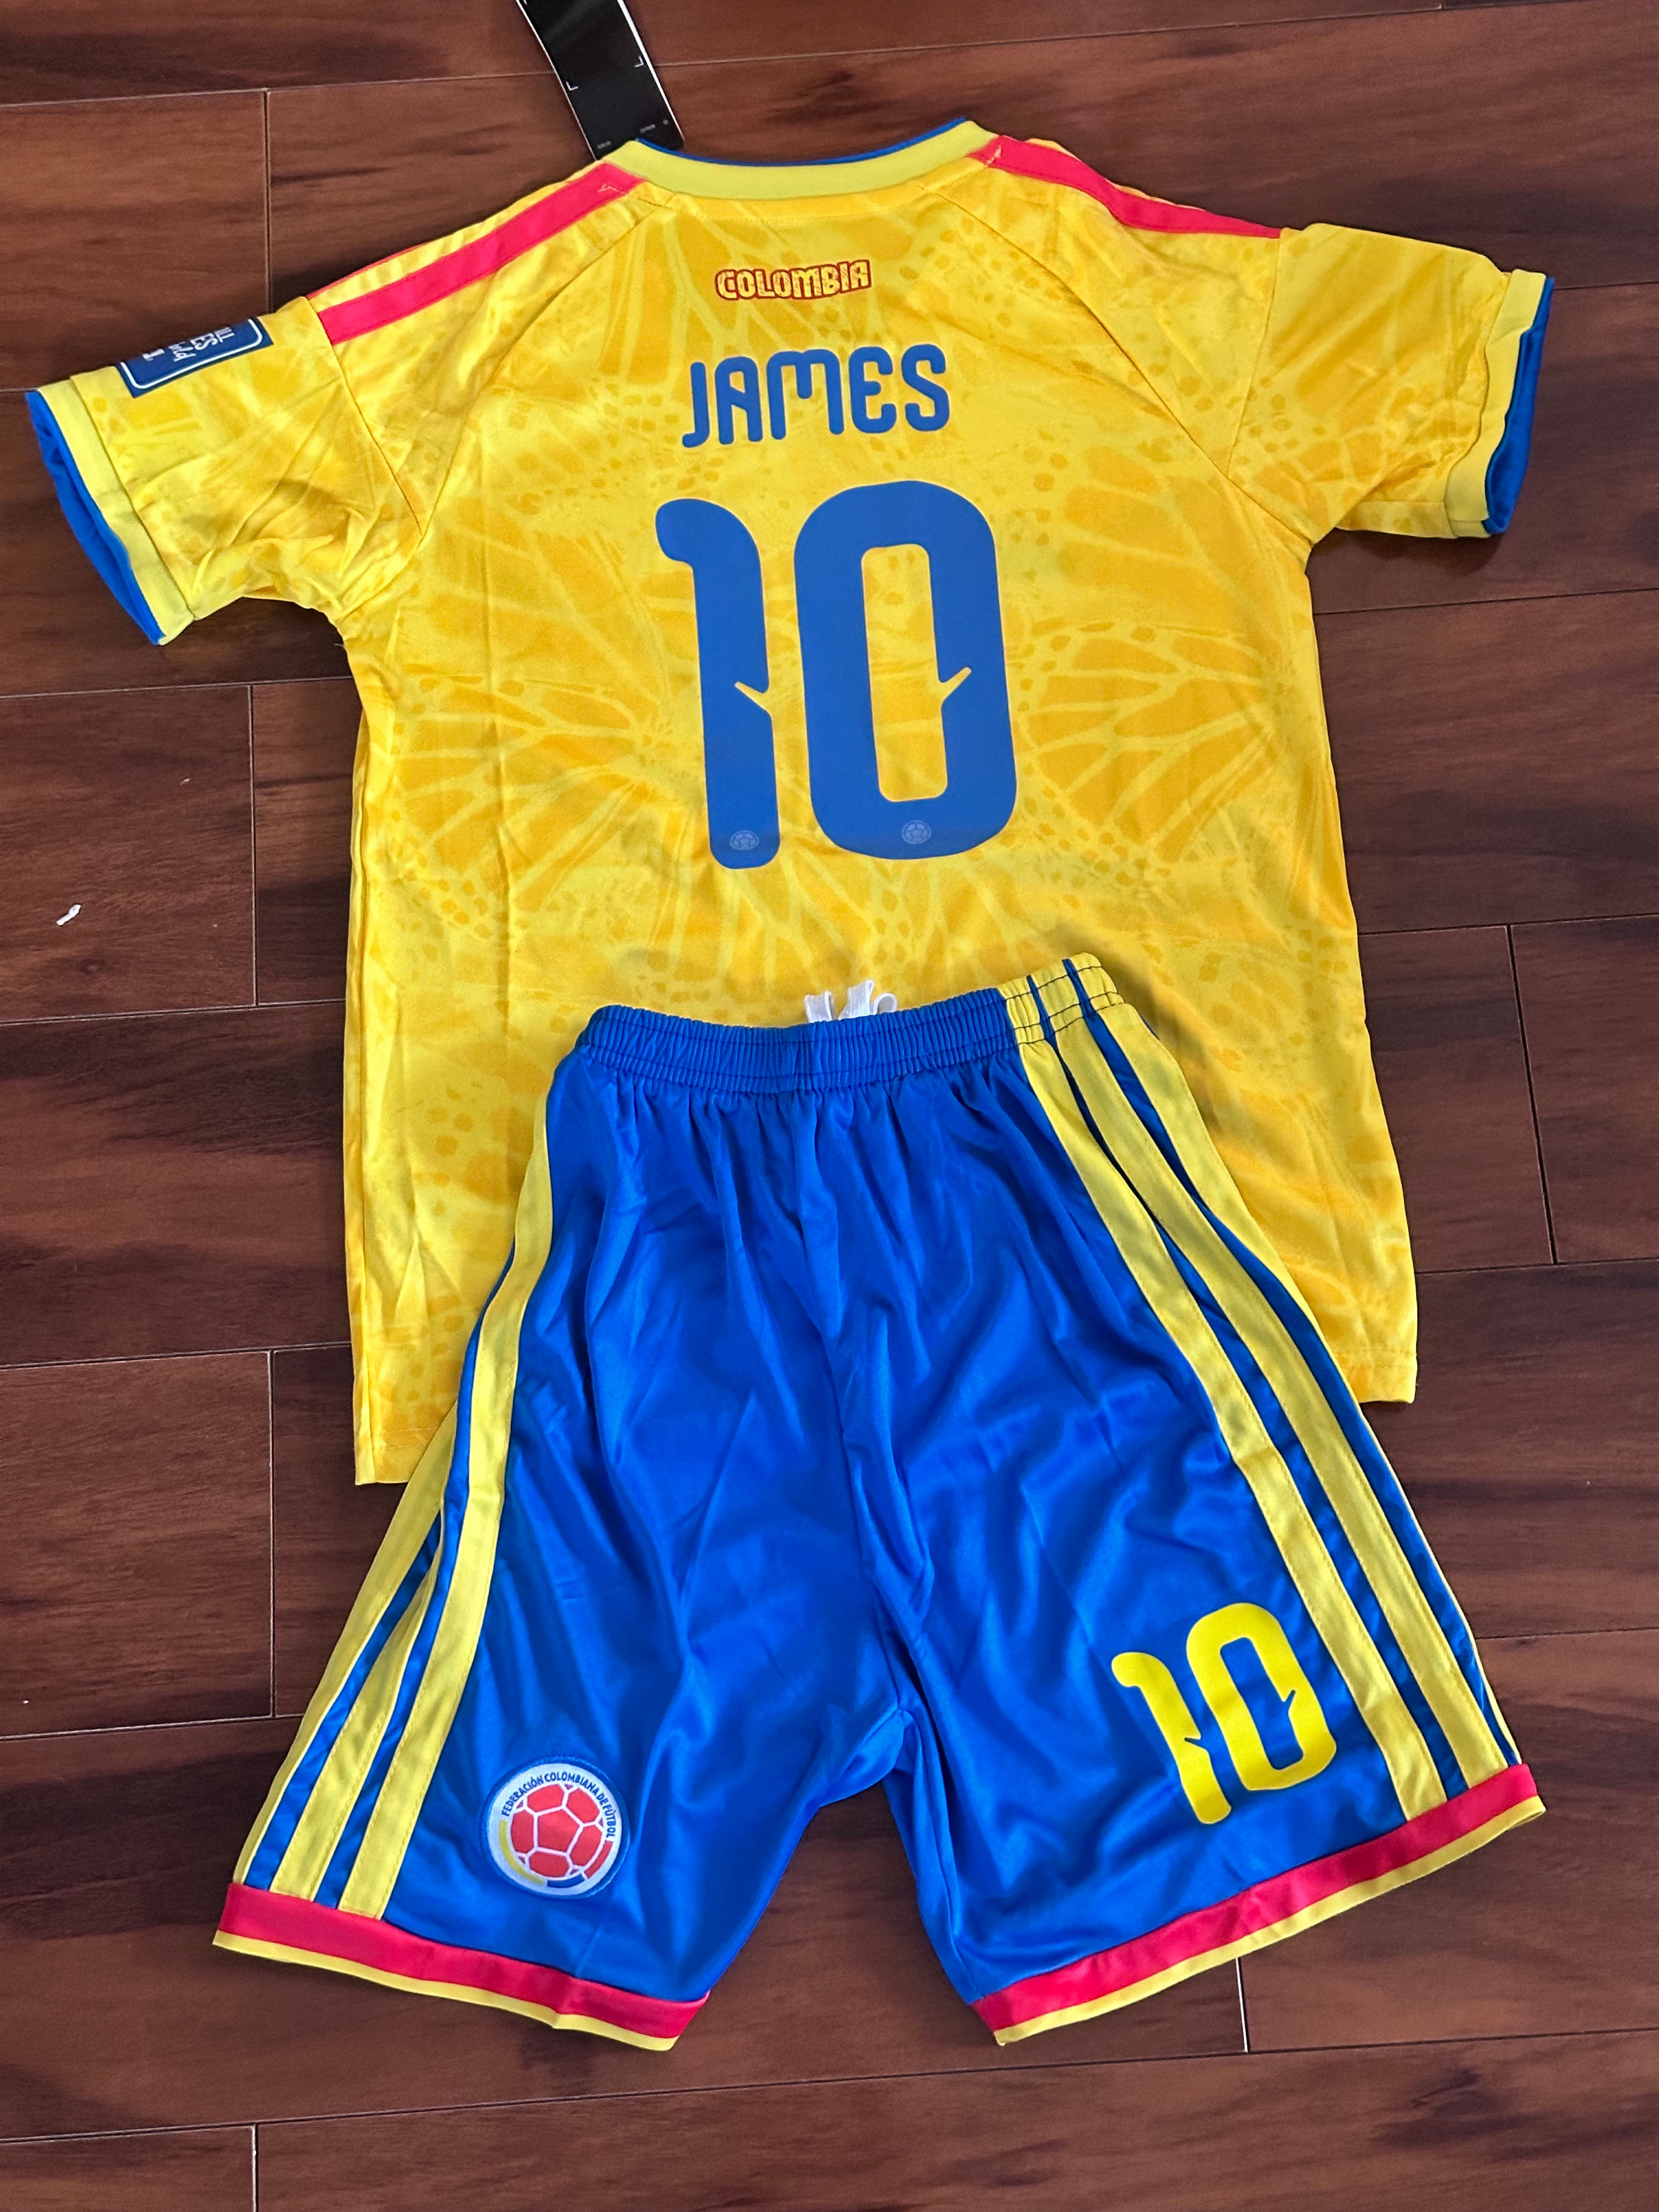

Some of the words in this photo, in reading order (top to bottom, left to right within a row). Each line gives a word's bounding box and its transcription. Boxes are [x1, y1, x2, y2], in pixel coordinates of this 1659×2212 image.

[715, 259, 871, 301] COLOMBIA
[682, 344, 950, 448] JAMES
[656, 480, 1016, 870] 10
[1111, 1602, 1338, 1825] 10
[501, 1775, 544, 1816] FEDERACIÓN
[544, 1771, 599, 1796] COLOMBIANA
[596, 1793, 608, 1805] DE
[602, 1804, 617, 1838] FÚTBOL
